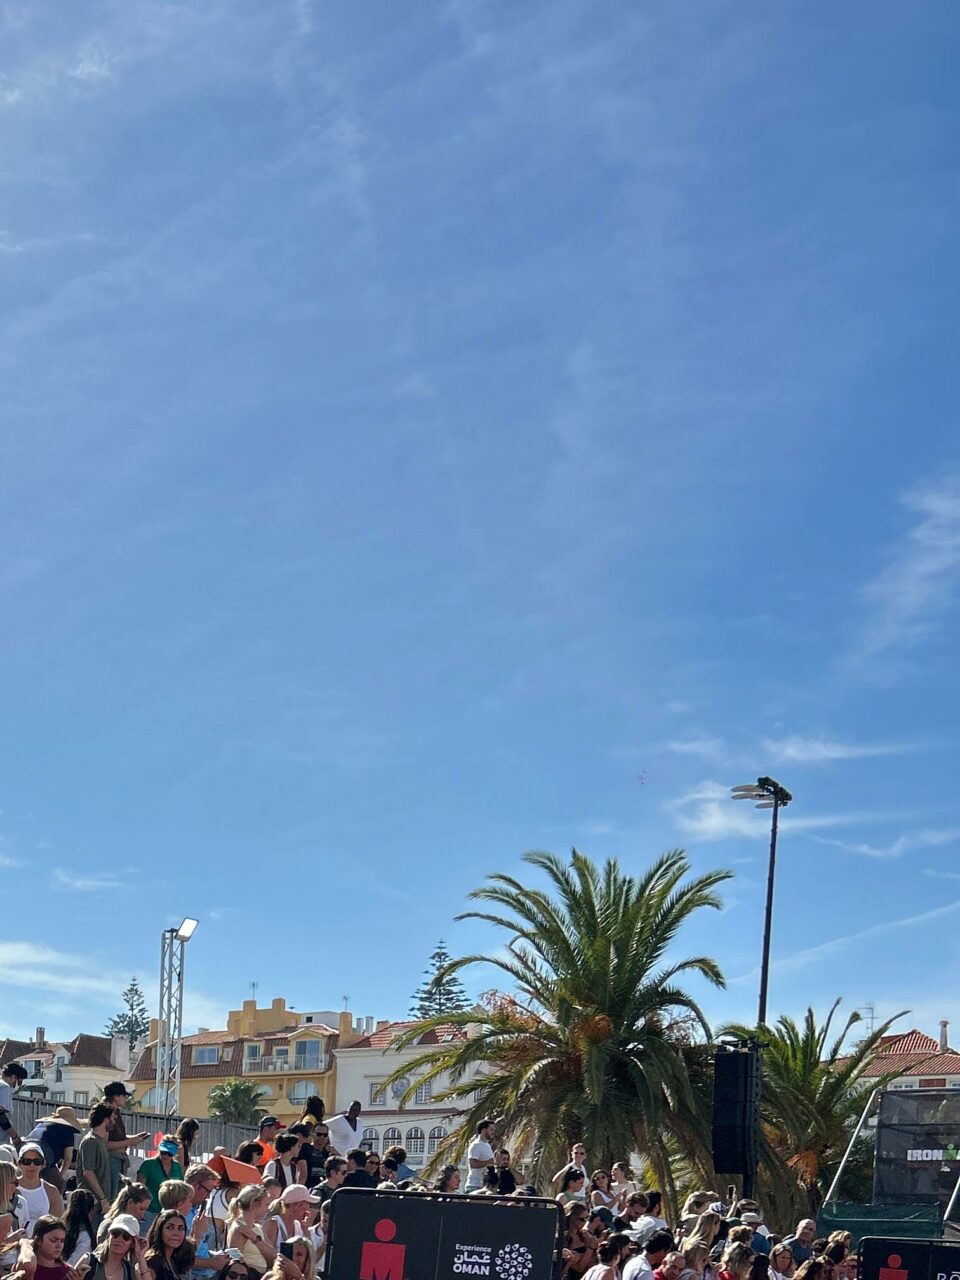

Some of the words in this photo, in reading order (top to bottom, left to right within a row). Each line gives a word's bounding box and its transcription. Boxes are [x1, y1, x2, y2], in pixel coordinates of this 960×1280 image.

[906, 1143, 960, 1161] IRONM
[455, 1243, 492, 1253] Experience
[452, 1263, 490, 1276] OMAN
